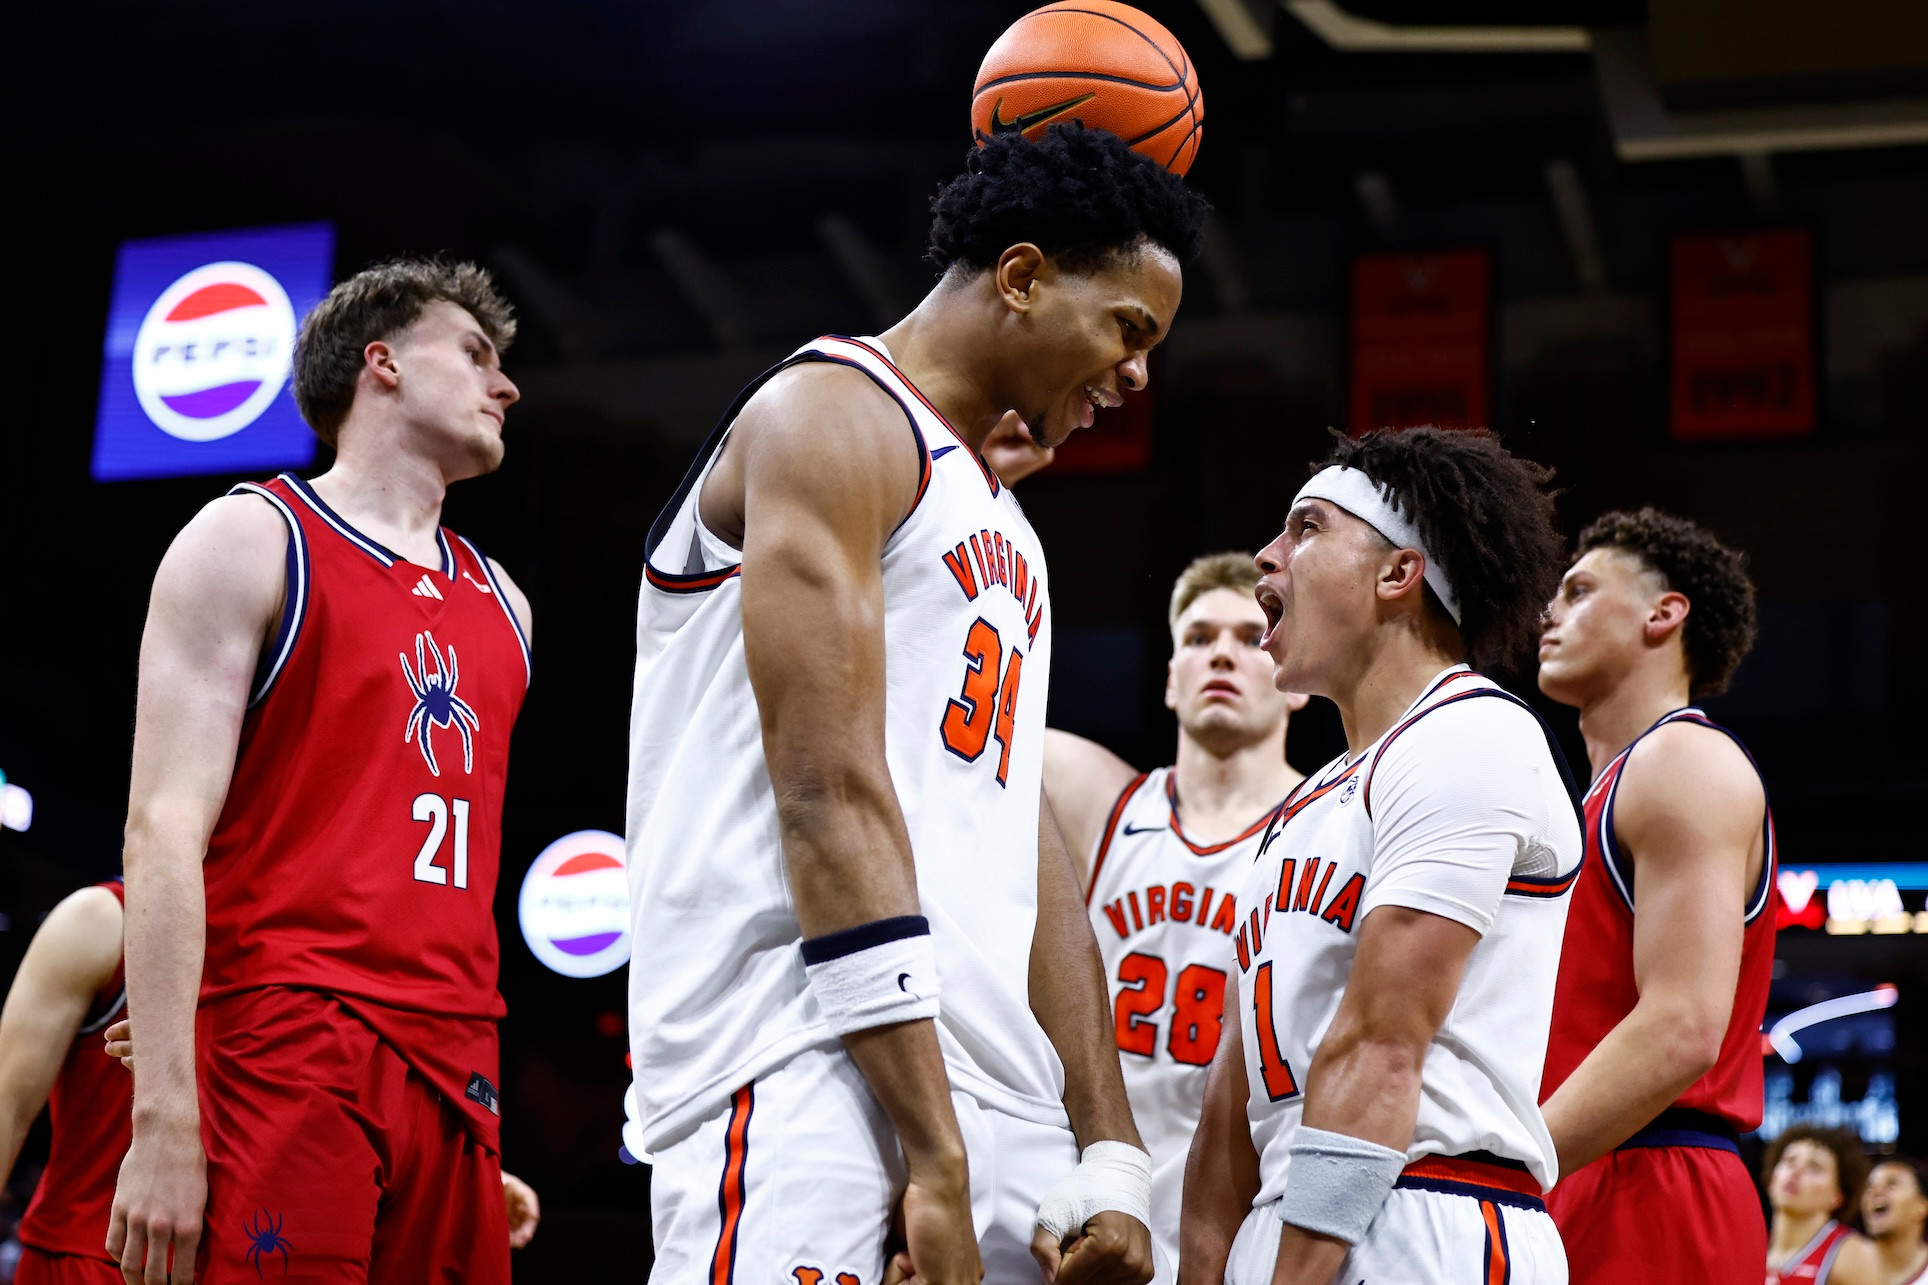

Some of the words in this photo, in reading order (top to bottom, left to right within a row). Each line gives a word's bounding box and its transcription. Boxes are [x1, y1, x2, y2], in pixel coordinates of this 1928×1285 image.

[942, 528, 1043, 653] VIRGINIA
[939, 615, 1024, 790] 34
[410, 791, 471, 890] 21
[1114, 951, 1228, 1068] 28
[1253, 959, 1300, 1103] 1
